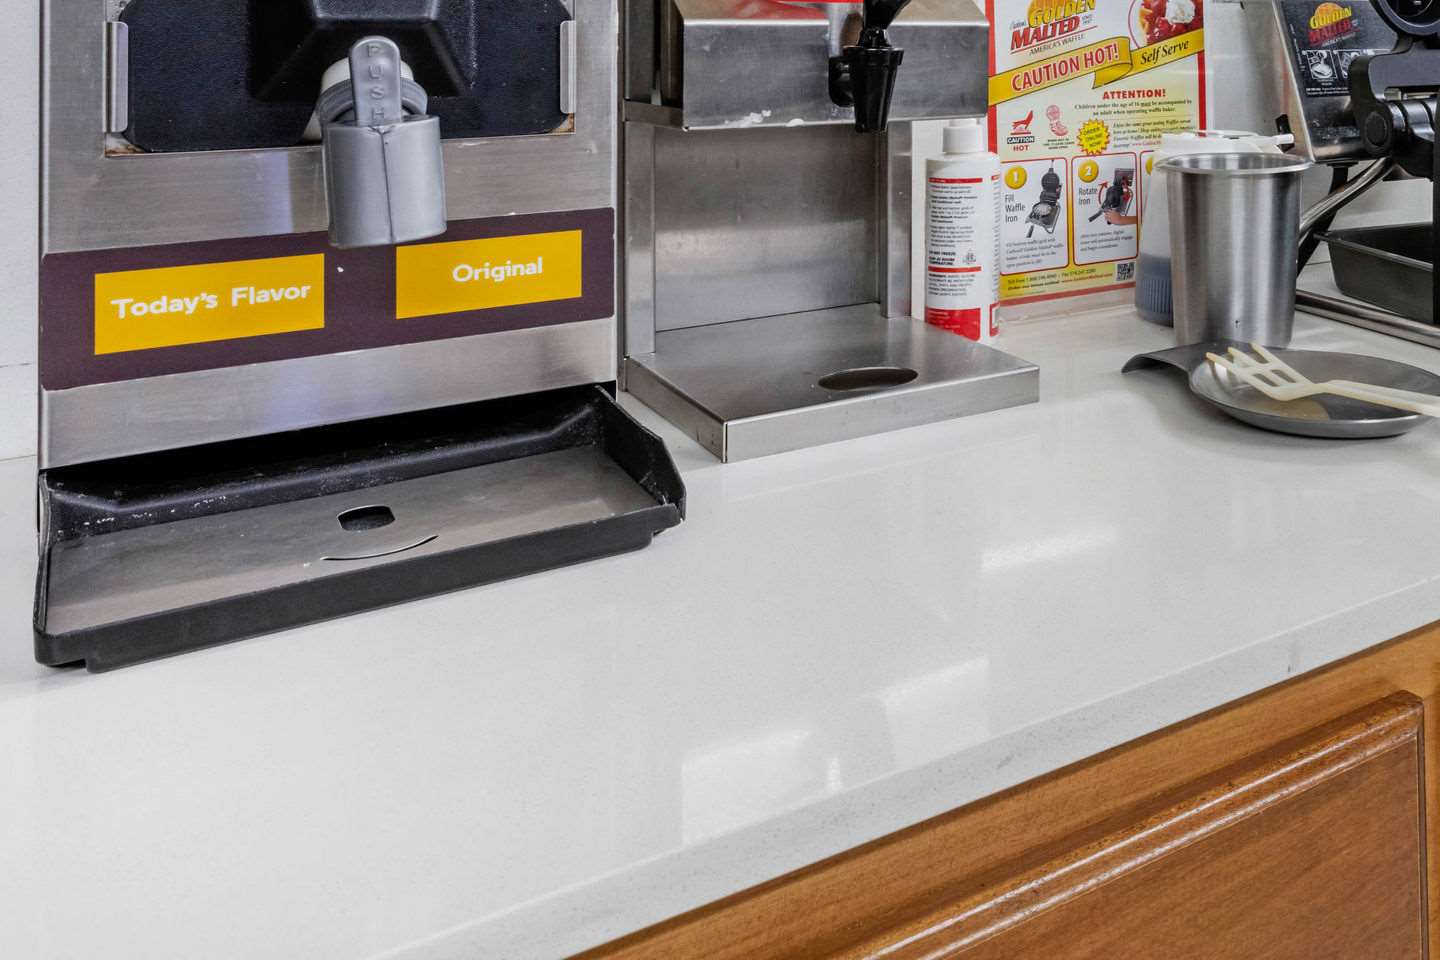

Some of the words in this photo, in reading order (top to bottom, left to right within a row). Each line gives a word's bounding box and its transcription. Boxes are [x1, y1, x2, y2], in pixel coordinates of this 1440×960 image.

[1010, 15, 1081, 51] MALTED
[1140, 48, 1162, 66] Self
[1162, 39, 1190, 58] Serve
[1011, 54, 1080, 92] CAUTION
[1084, 43, 1120, 69] HOT!
[1102, 88, 1166, 101] ATTENTION!
[1013, 144, 1030, 152] HOT
[1078, 186, 1098, 196] Rotate
[1004, 193, 1015, 203] Fill
[1078, 196, 1091, 206] Iron
[1004, 203, 1026, 213] Waffle
[1004, 214, 1018, 224] Iron
[451, 257, 544, 286] Original
[109, 293, 219, 319] Today's
[230, 283, 312, 308] Flavor
